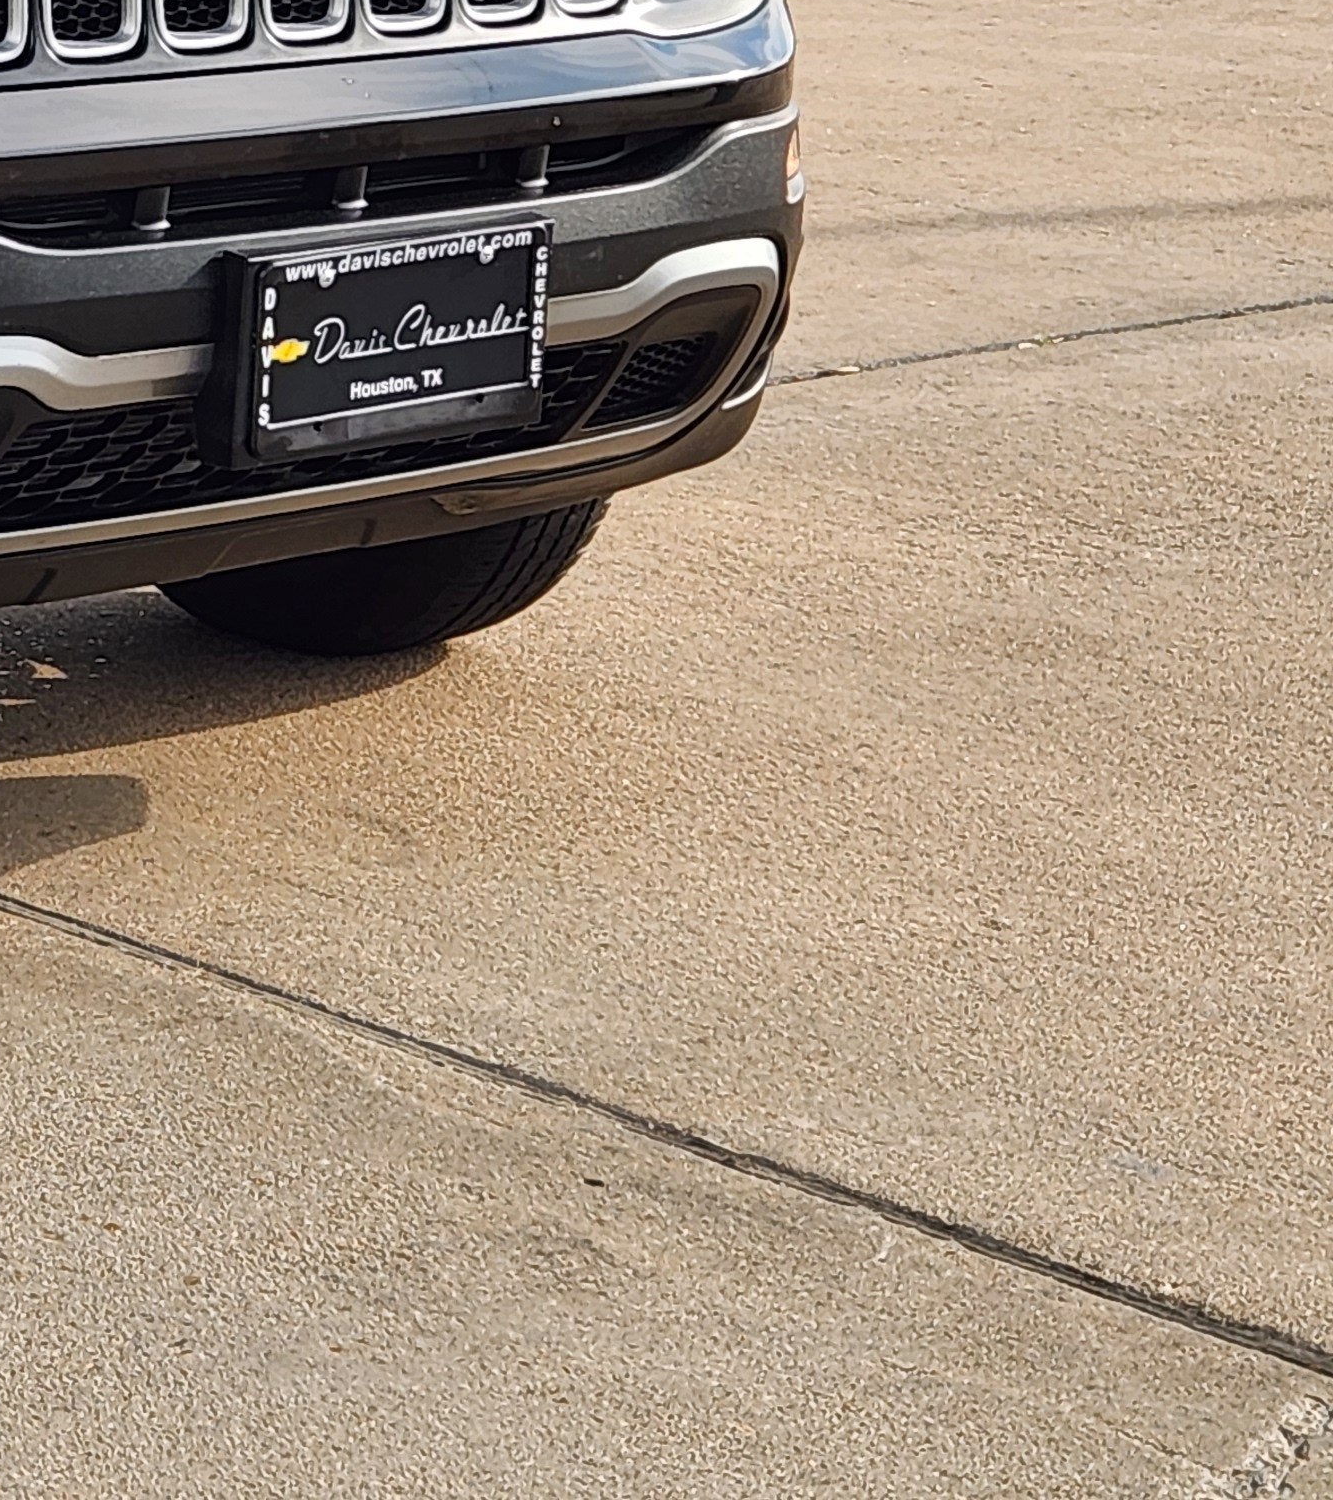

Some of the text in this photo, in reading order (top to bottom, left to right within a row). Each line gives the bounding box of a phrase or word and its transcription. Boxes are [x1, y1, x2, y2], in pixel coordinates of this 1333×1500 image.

[285, 230, 533, 283] www.davischevroletcom
[313, 302, 531, 364] Davis Chevrolet
[530, 246, 549, 388] CHEVROLET
[258, 286, 277, 426] DAVIS
[350, 367, 444, 401] Houston, TX
